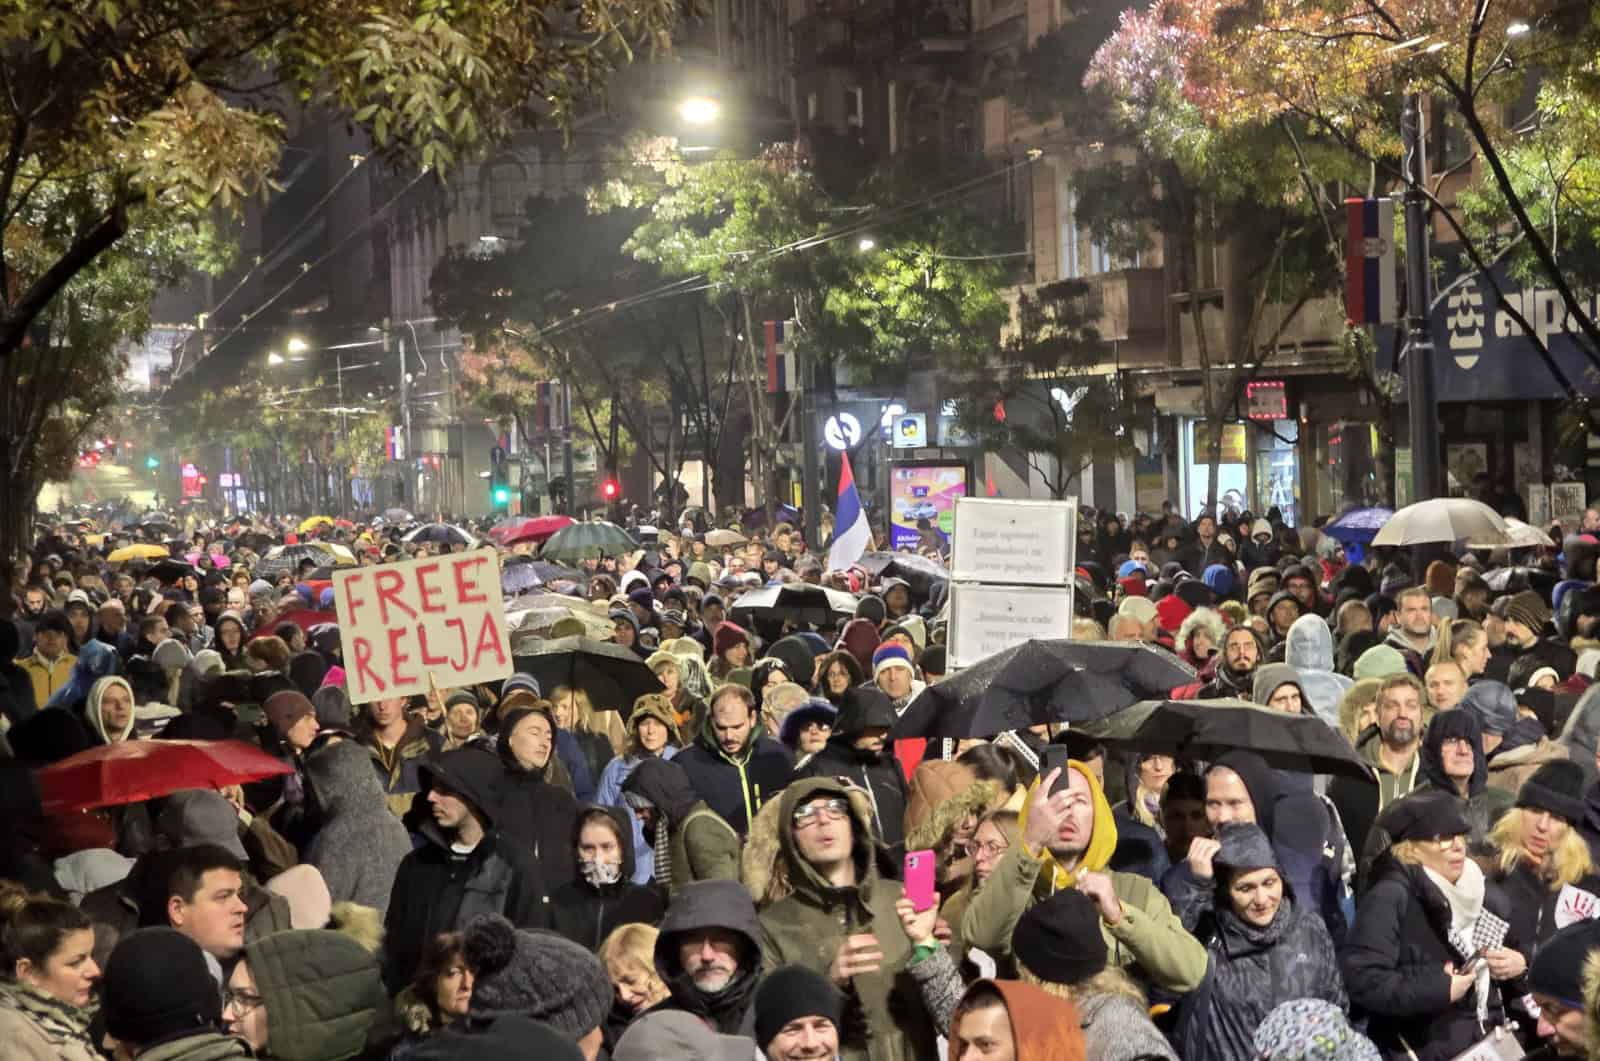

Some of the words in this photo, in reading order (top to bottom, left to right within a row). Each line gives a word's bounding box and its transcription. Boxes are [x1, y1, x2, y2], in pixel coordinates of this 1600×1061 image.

[1495, 288, 1600, 351] alp
[343, 556, 489, 626] FREE
[353, 611, 506, 694] RELJA
